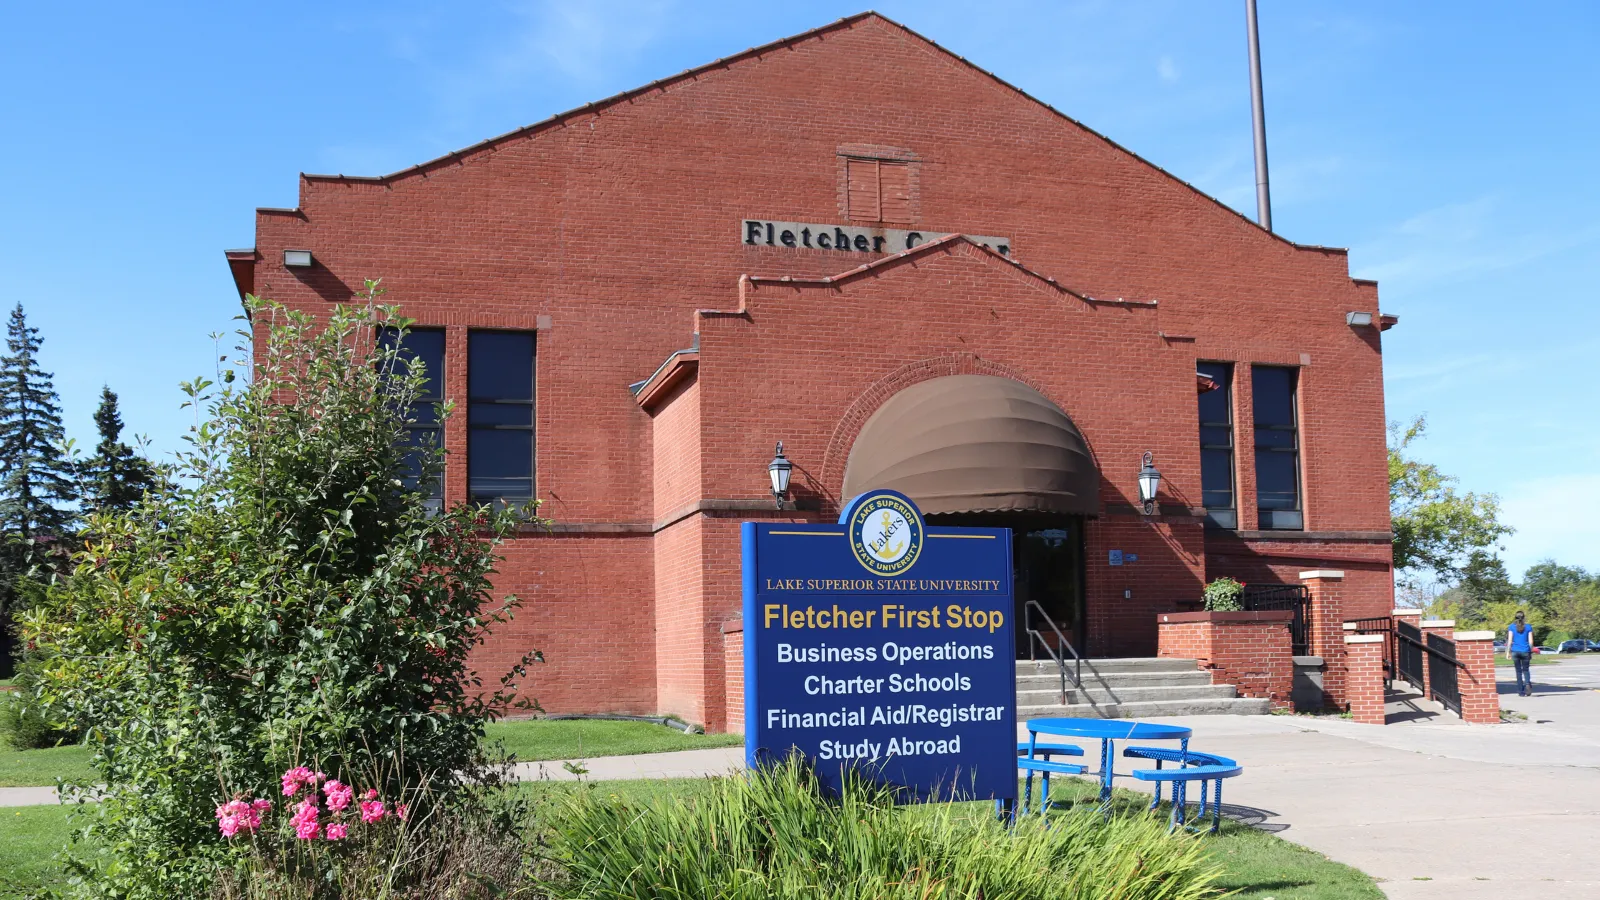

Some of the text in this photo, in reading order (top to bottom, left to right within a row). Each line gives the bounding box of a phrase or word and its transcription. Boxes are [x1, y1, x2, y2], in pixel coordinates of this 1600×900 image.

[745, 221, 887, 253] Fletcher
[857, 500, 915, 525] LAKE SUPERIOR
[868, 516, 903, 554] Lakers
[856, 542, 917, 571] STATE UNIVERSITY
[767, 579, 1000, 590] LAKE SUPERIOR STATE UNIVERSITY
[764, 604, 1004, 633] Fletcher First Stop
[777, 641, 994, 665] Business Operations
[804, 672, 971, 695] Charter Schools
[767, 703, 1004, 729] Financial Aid/Registrar
[819, 735, 961, 762] Study Abroad
